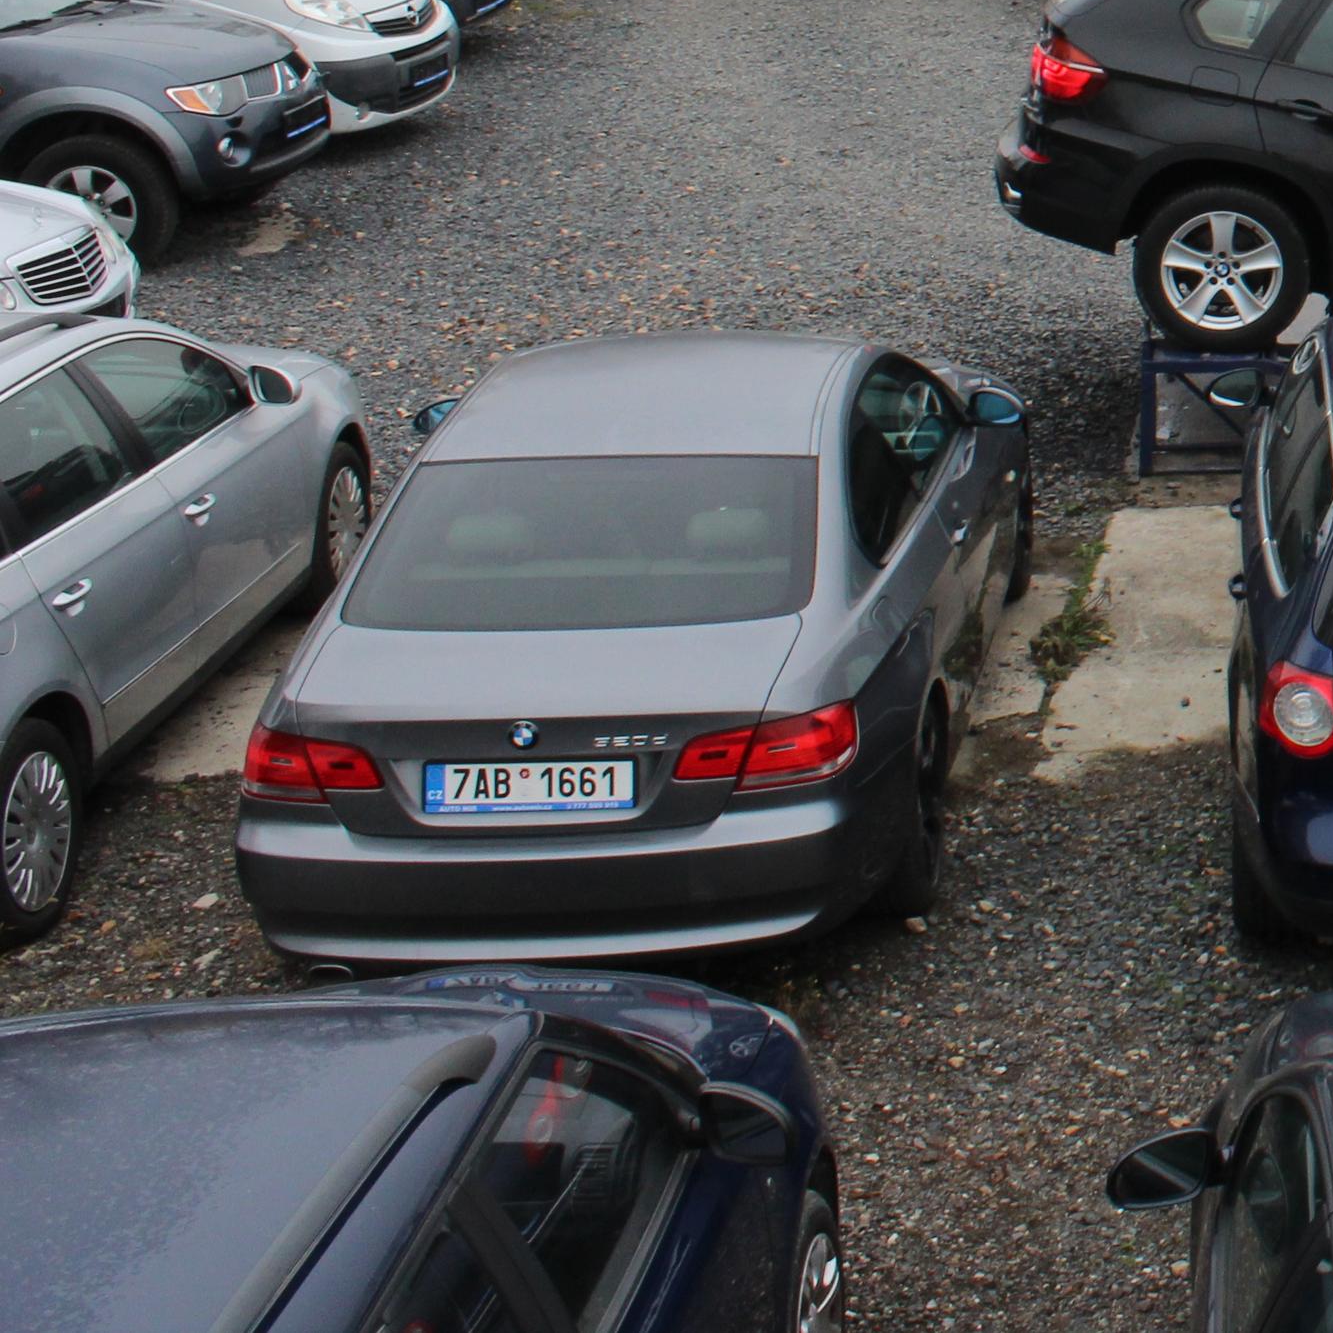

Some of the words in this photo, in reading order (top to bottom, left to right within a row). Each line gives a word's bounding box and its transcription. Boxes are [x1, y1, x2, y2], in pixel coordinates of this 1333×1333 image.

[452, 767, 511, 800] 7AB
[540, 765, 616, 798] 1661
[427, 789, 444, 800] CZ
